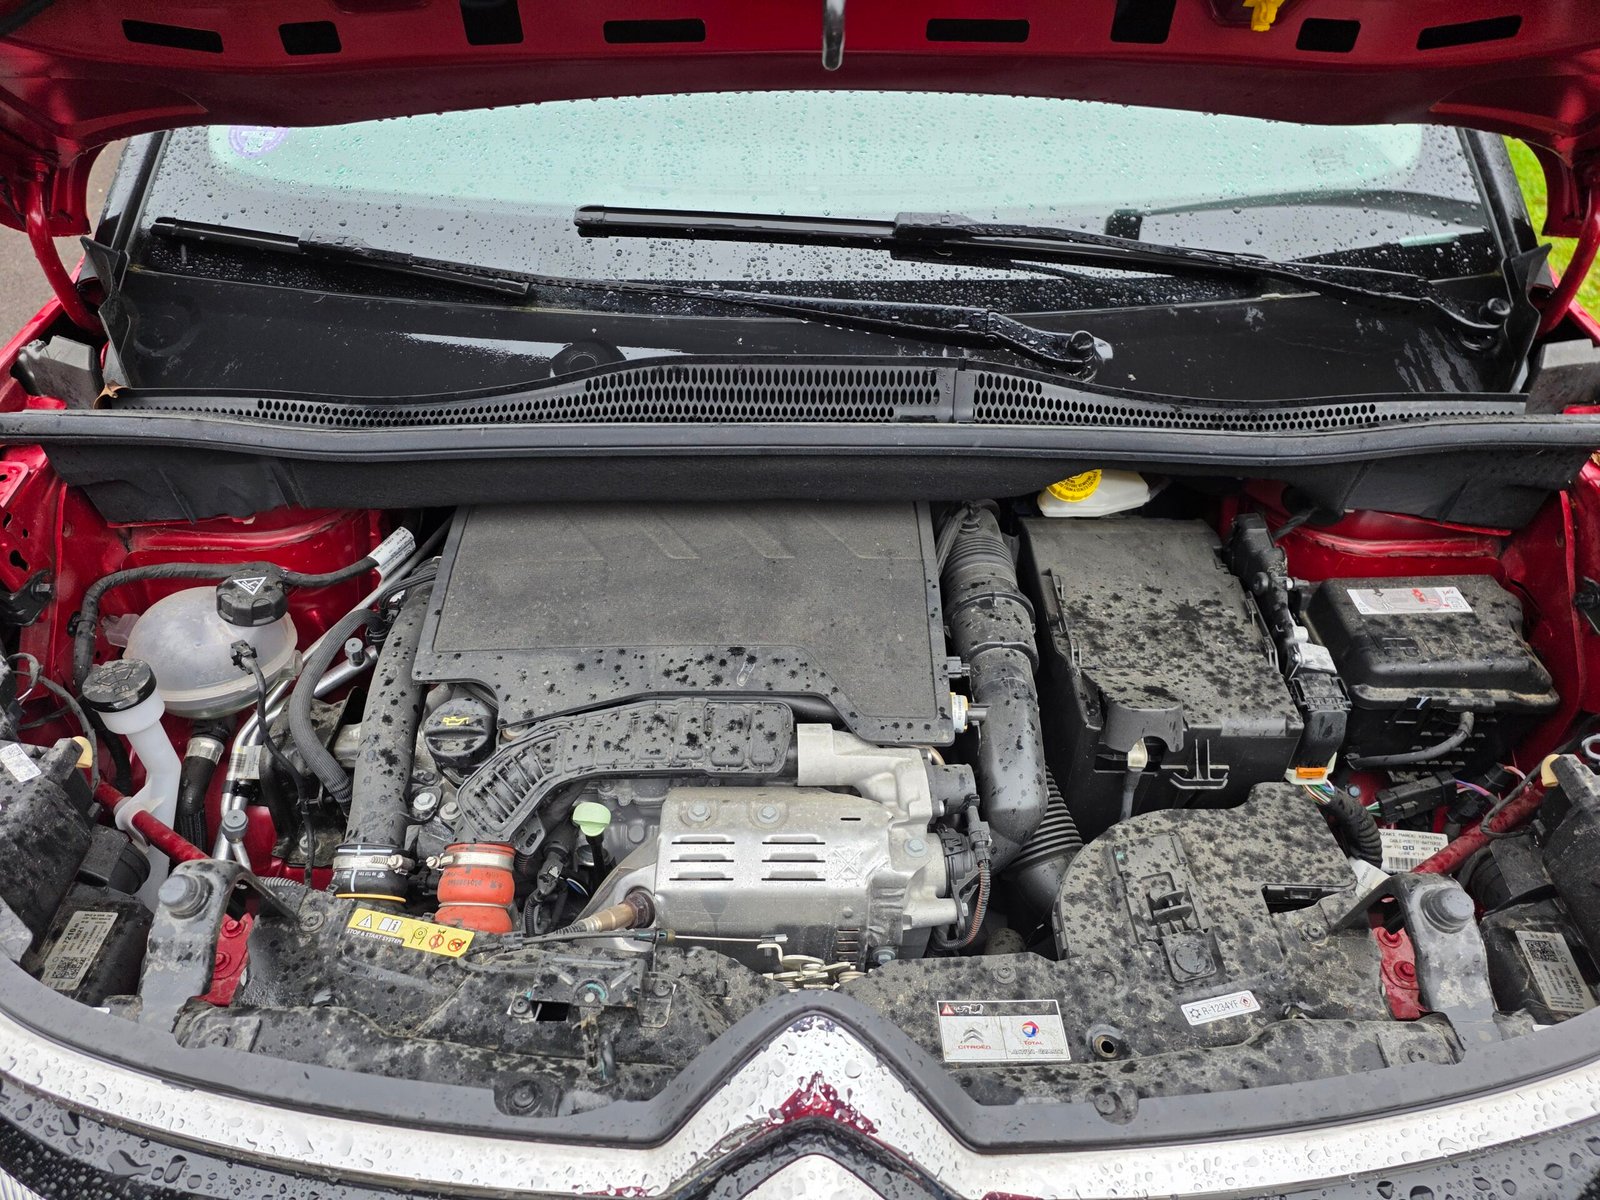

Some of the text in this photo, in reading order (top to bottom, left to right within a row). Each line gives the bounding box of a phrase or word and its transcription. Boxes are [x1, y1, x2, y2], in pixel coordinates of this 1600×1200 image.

[346, 928, 361, 936] STOP
[365, 931, 382, 940] START
[381, 935, 403, 945] SYSTEM
[1201, 1000, 1239, 1015] R-1234YF
